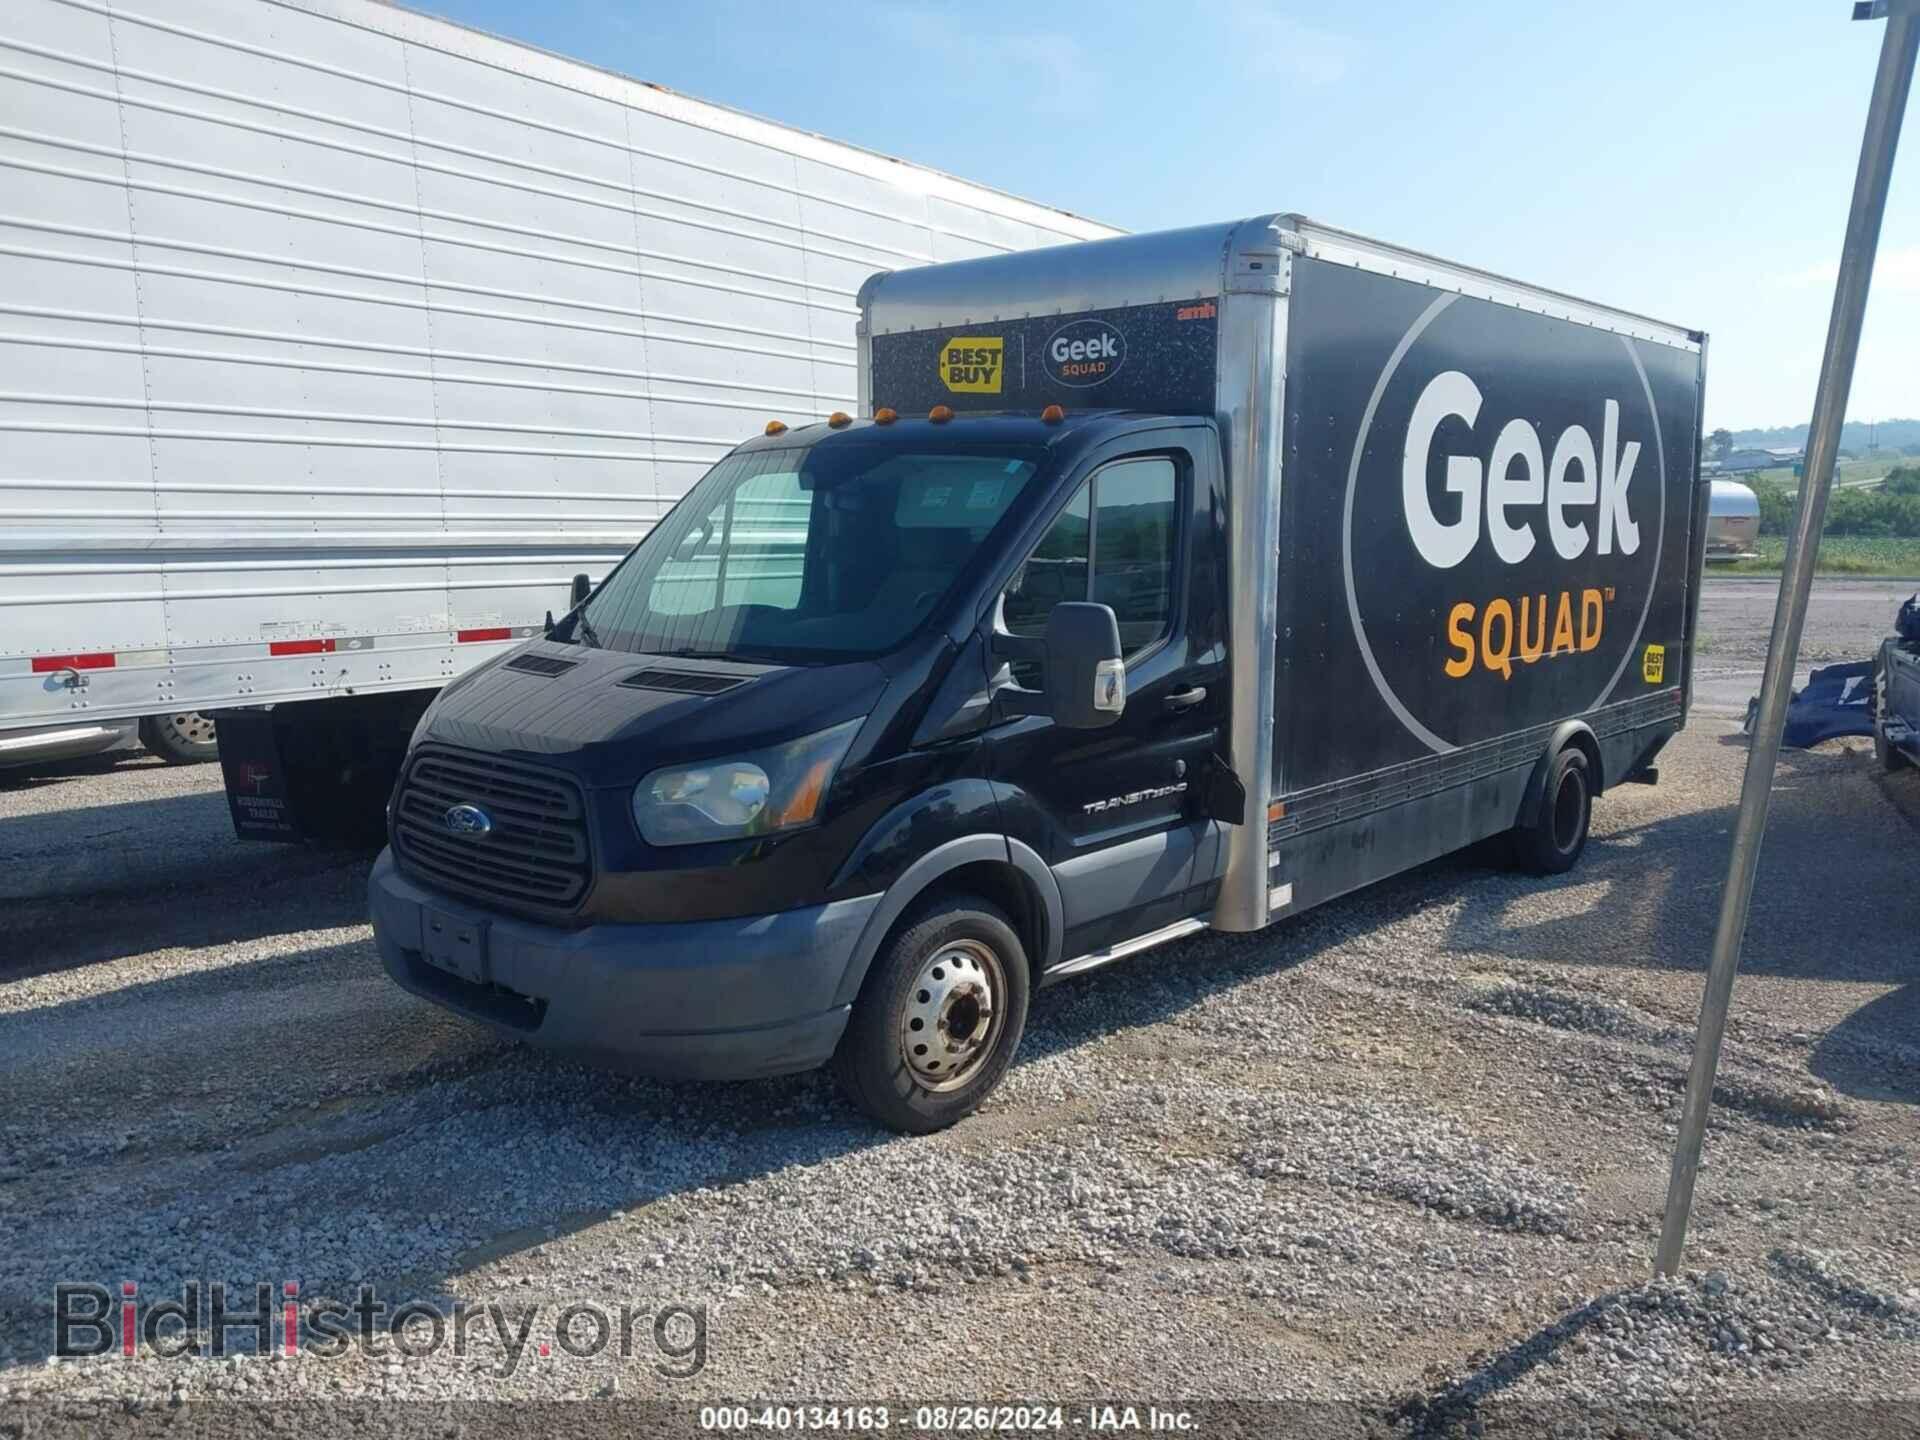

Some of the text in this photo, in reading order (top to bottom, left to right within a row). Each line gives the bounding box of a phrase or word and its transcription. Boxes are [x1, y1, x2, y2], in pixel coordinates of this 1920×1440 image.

[947, 348, 1002, 366] BEST
[1051, 333, 1118, 363] Geek
[949, 366, 997, 385] BUY
[1062, 362, 1106, 377] SQUAD
[1402, 370, 1642, 569] Geek
[1444, 588, 1604, 681] SQUAD
[1647, 651, 1664, 664] BEST
[1647, 663, 1662, 677] BUY
[1083, 788, 1155, 816] TRANSIT
